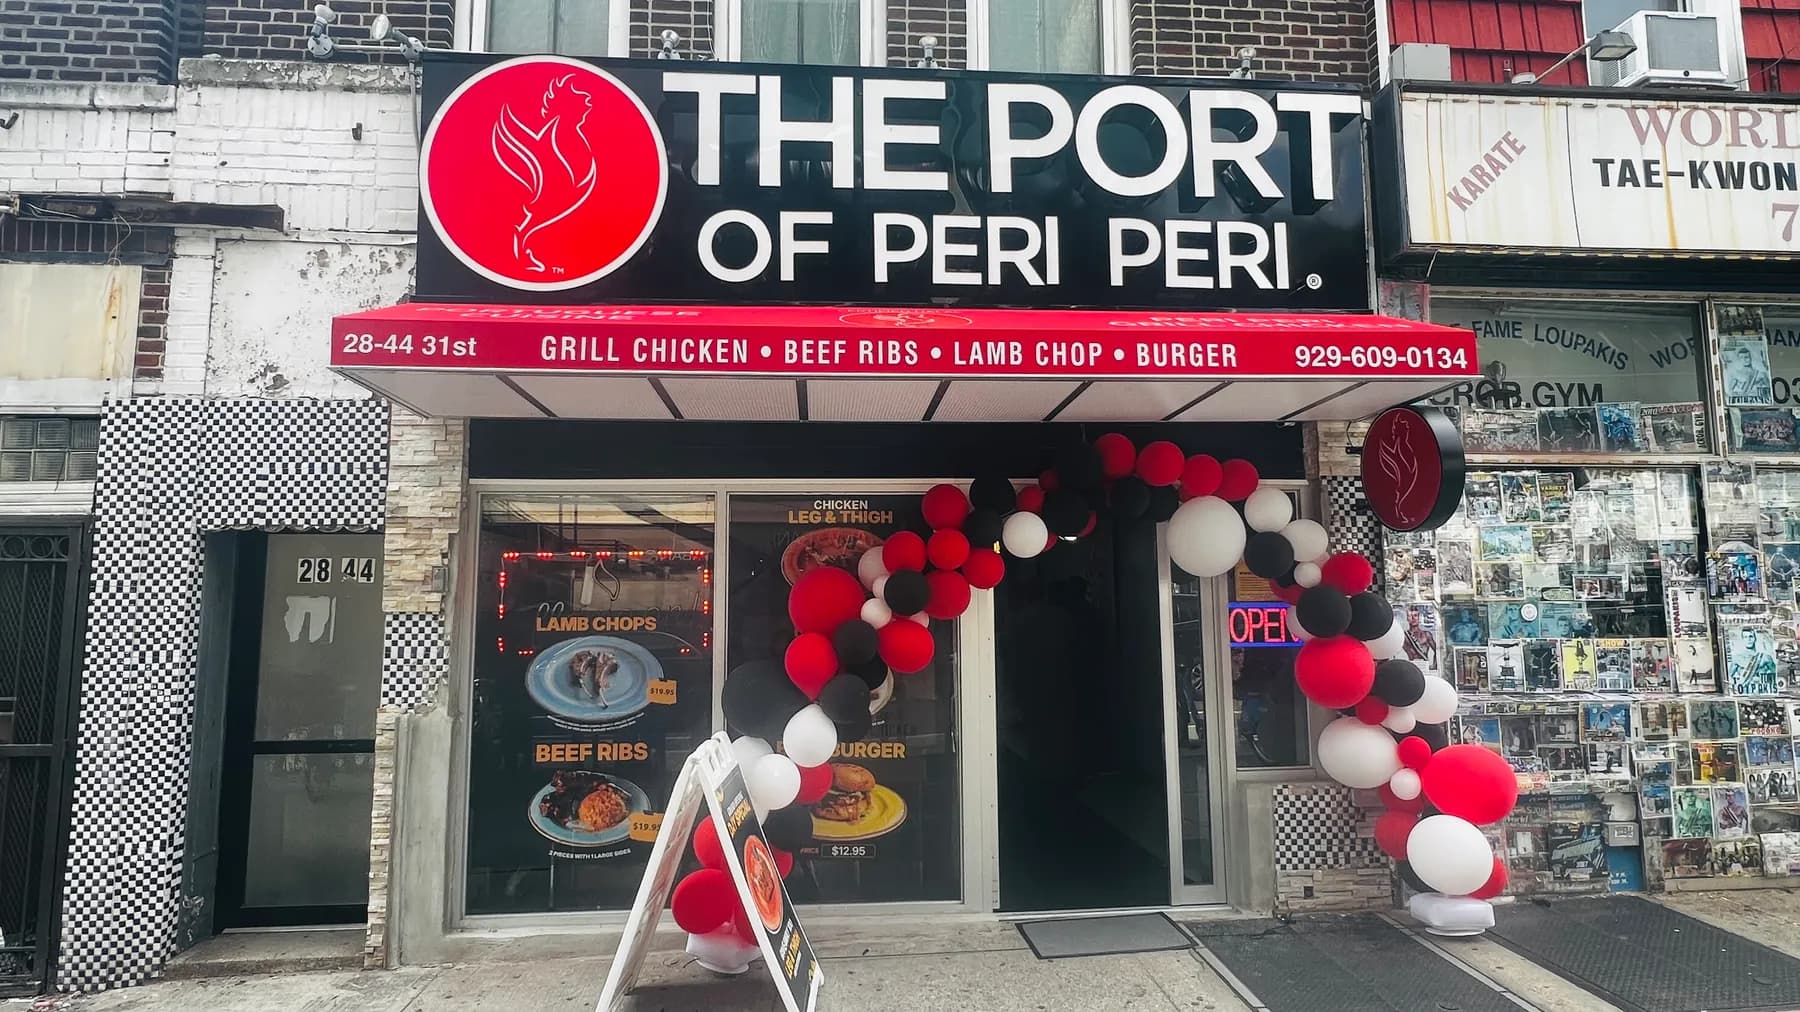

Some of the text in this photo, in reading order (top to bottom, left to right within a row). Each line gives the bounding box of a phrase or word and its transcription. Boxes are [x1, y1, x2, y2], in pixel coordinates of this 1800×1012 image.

[663, 72, 1361, 201] THE PORT
[1446, 130, 1527, 212] KARATE
[1592, 158, 1798, 191] TAE-KWON
[698, 210, 834, 283] OF
[874, 213, 1060, 287] PERI
[1108, 217, 1290, 290] PERI
[344, 333, 477, 356] 28-44 31st
[541, 336, 748, 363] GRILL CHICKEN
[784, 340, 919, 365] BEEF RIBS
[954, 341, 1102, 367] LAMB CHOP
[1136, 343, 1238, 367] BURGER
[1472, 320, 1629, 371] FAME LOUPAKIS
[1295, 345, 1468, 369] 929-609-0134
[814, 499, 868, 510] CHICKEN
[789, 511, 893, 524] LEG & THIGH
[299, 558, 374, 582] 28 44
[536, 615, 657, 632] LAMB CHOPS
[650, 687, 675, 696] $19.95
[536, 743, 649, 762] BEEF RIBS
[831, 846, 866, 857] $12.95
